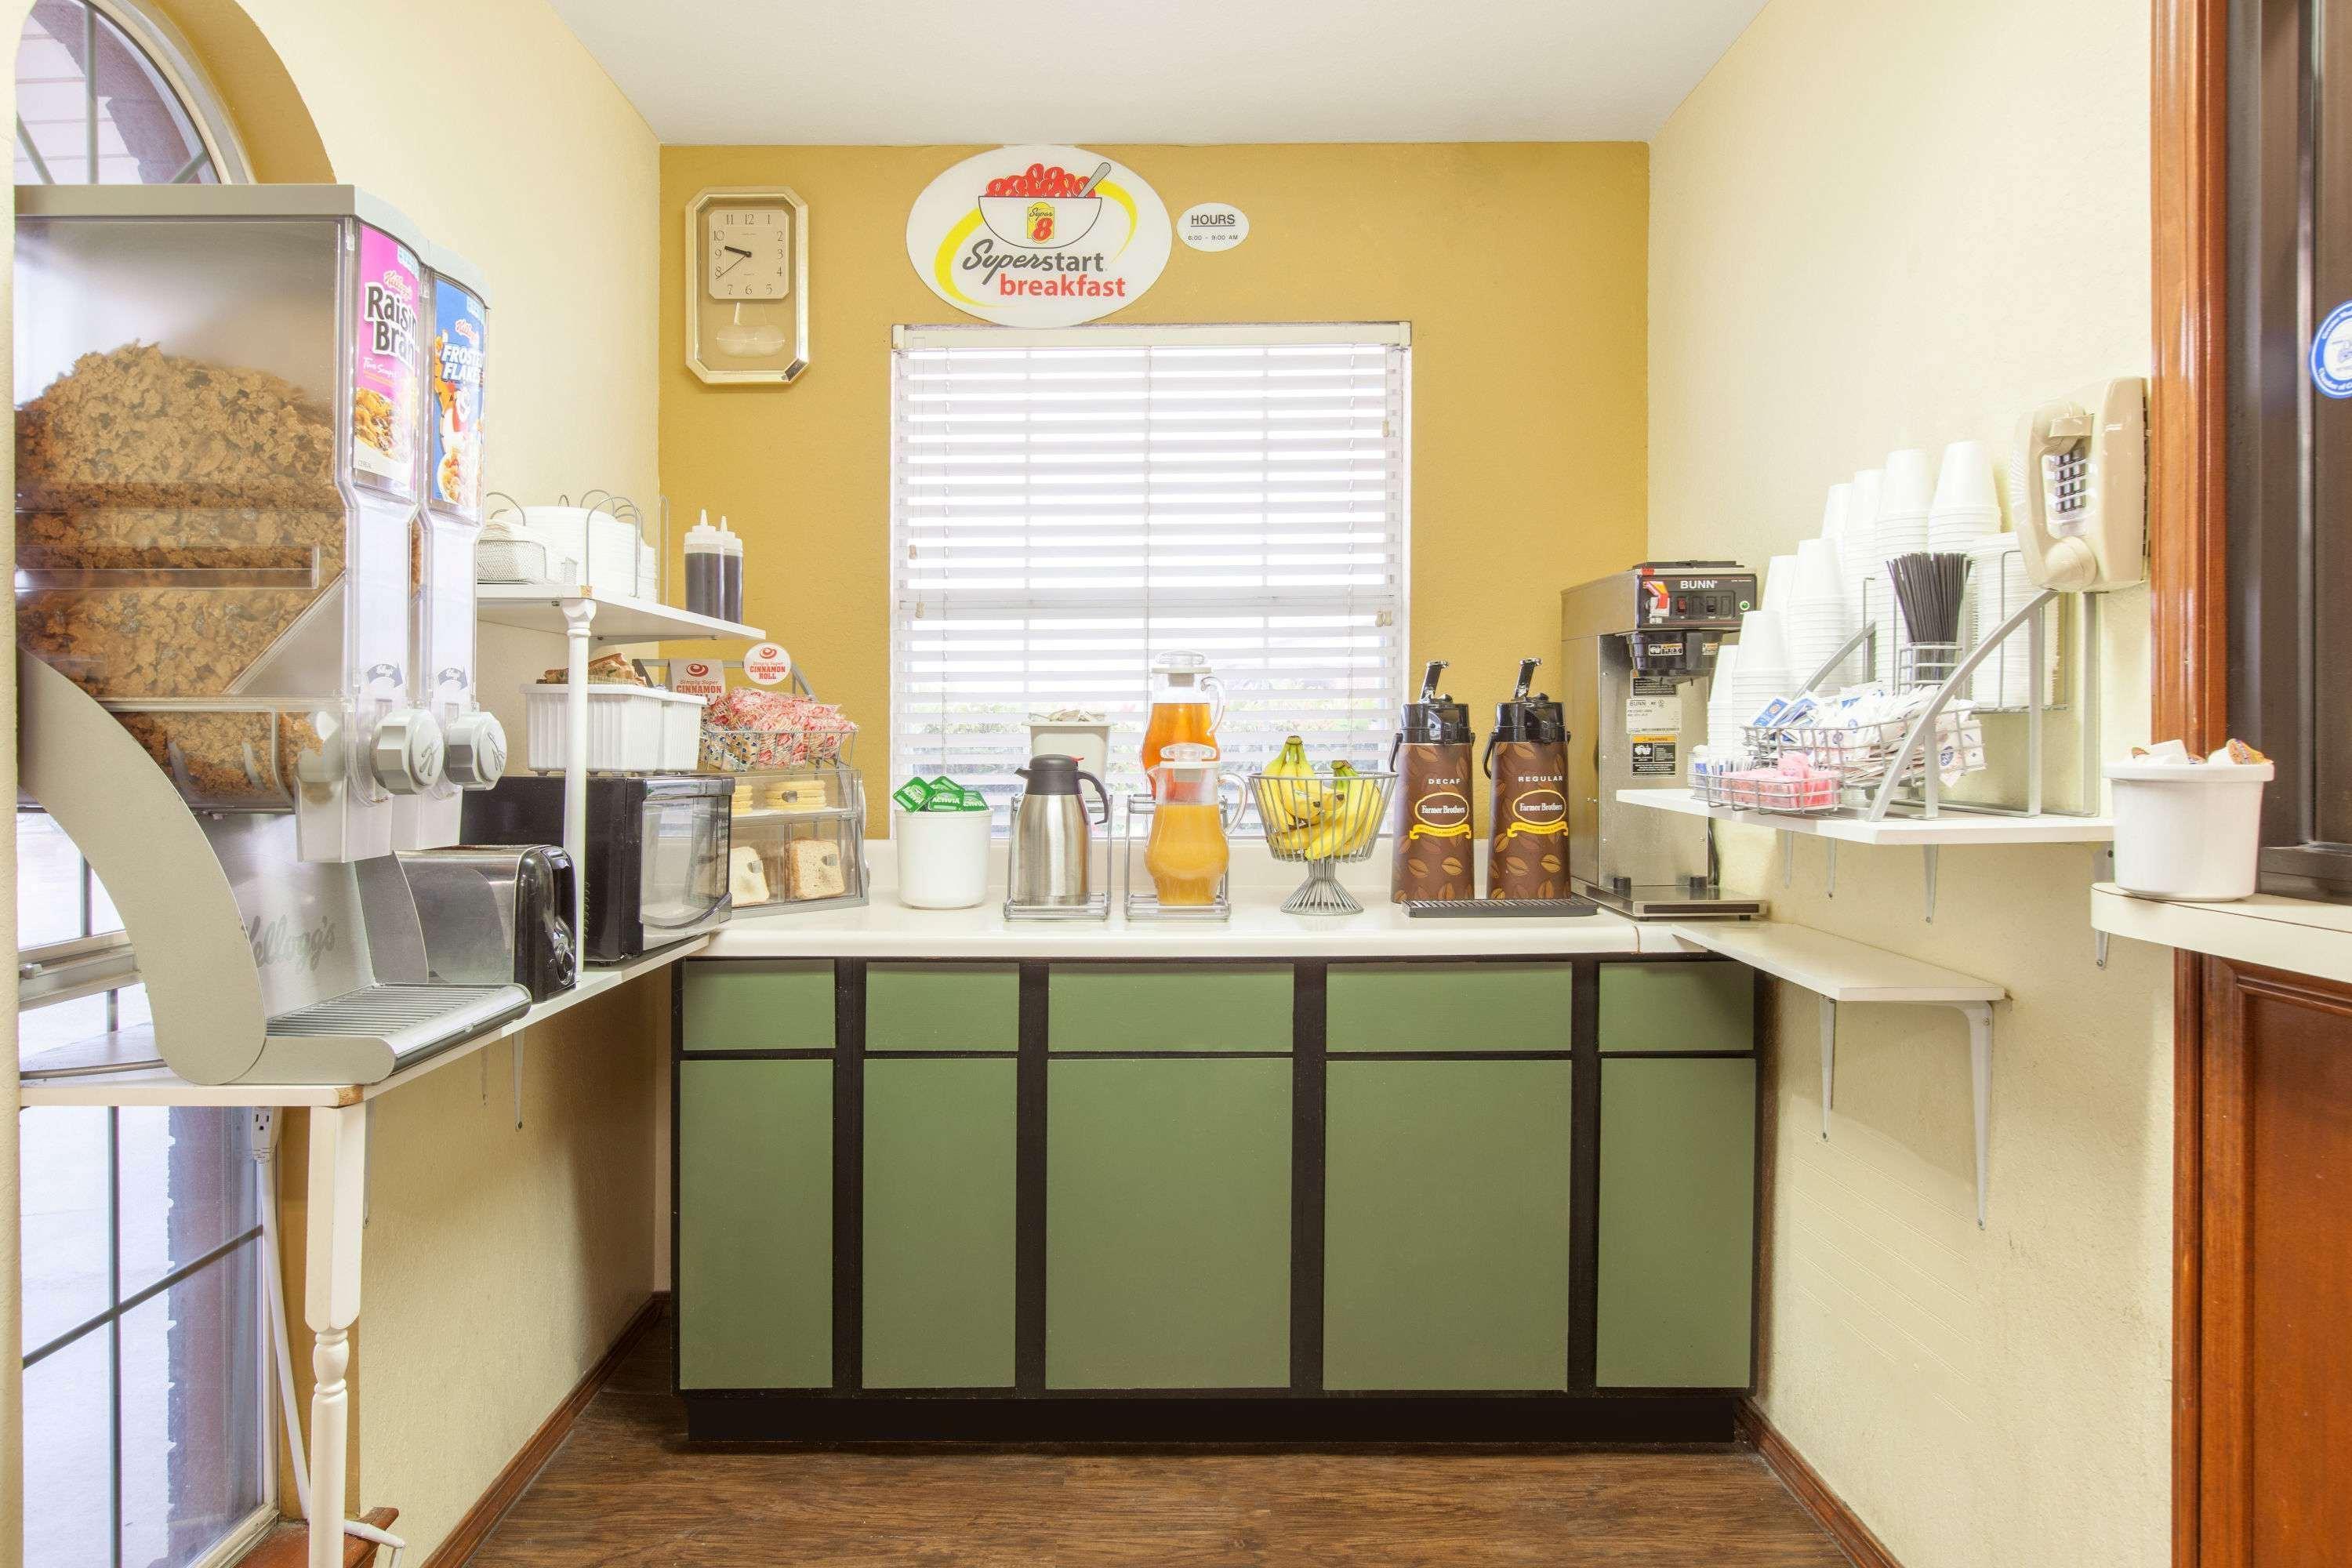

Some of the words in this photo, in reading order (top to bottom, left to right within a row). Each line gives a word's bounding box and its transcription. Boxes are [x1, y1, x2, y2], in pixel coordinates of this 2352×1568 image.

[726, 214, 734, 225] 11
[745, 213, 754, 225] 12
[767, 214, 771, 225] 1
[1029, 207, 1053, 221] Super
[1191, 214, 1236, 225] HOURS
[1033, 217, 1053, 241] 8
[713, 230, 725, 241] 10
[776, 230, 783, 241] 2
[714, 249, 722, 260] 9
[777, 249, 784, 260] 3
[962, 238, 1105, 285] Superstart
[714, 266, 722, 278] 8
[776, 267, 783, 277] 4
[727, 284, 734, 296] 7
[745, 284, 753, 295] 6
[765, 283, 772, 295] 5
[1000, 273, 1126, 297] breakfast
[375, 320, 415, 365] Bran
[1680, 580, 1715, 589] BUNN
[676, 685, 722, 694] CINNAMON
[1421, 804, 1443, 814] Farmer
[1443, 804, 1465, 814] Brothers
[1519, 802, 1541, 811] Farmer
[1541, 802, 1563, 811] Brothers
